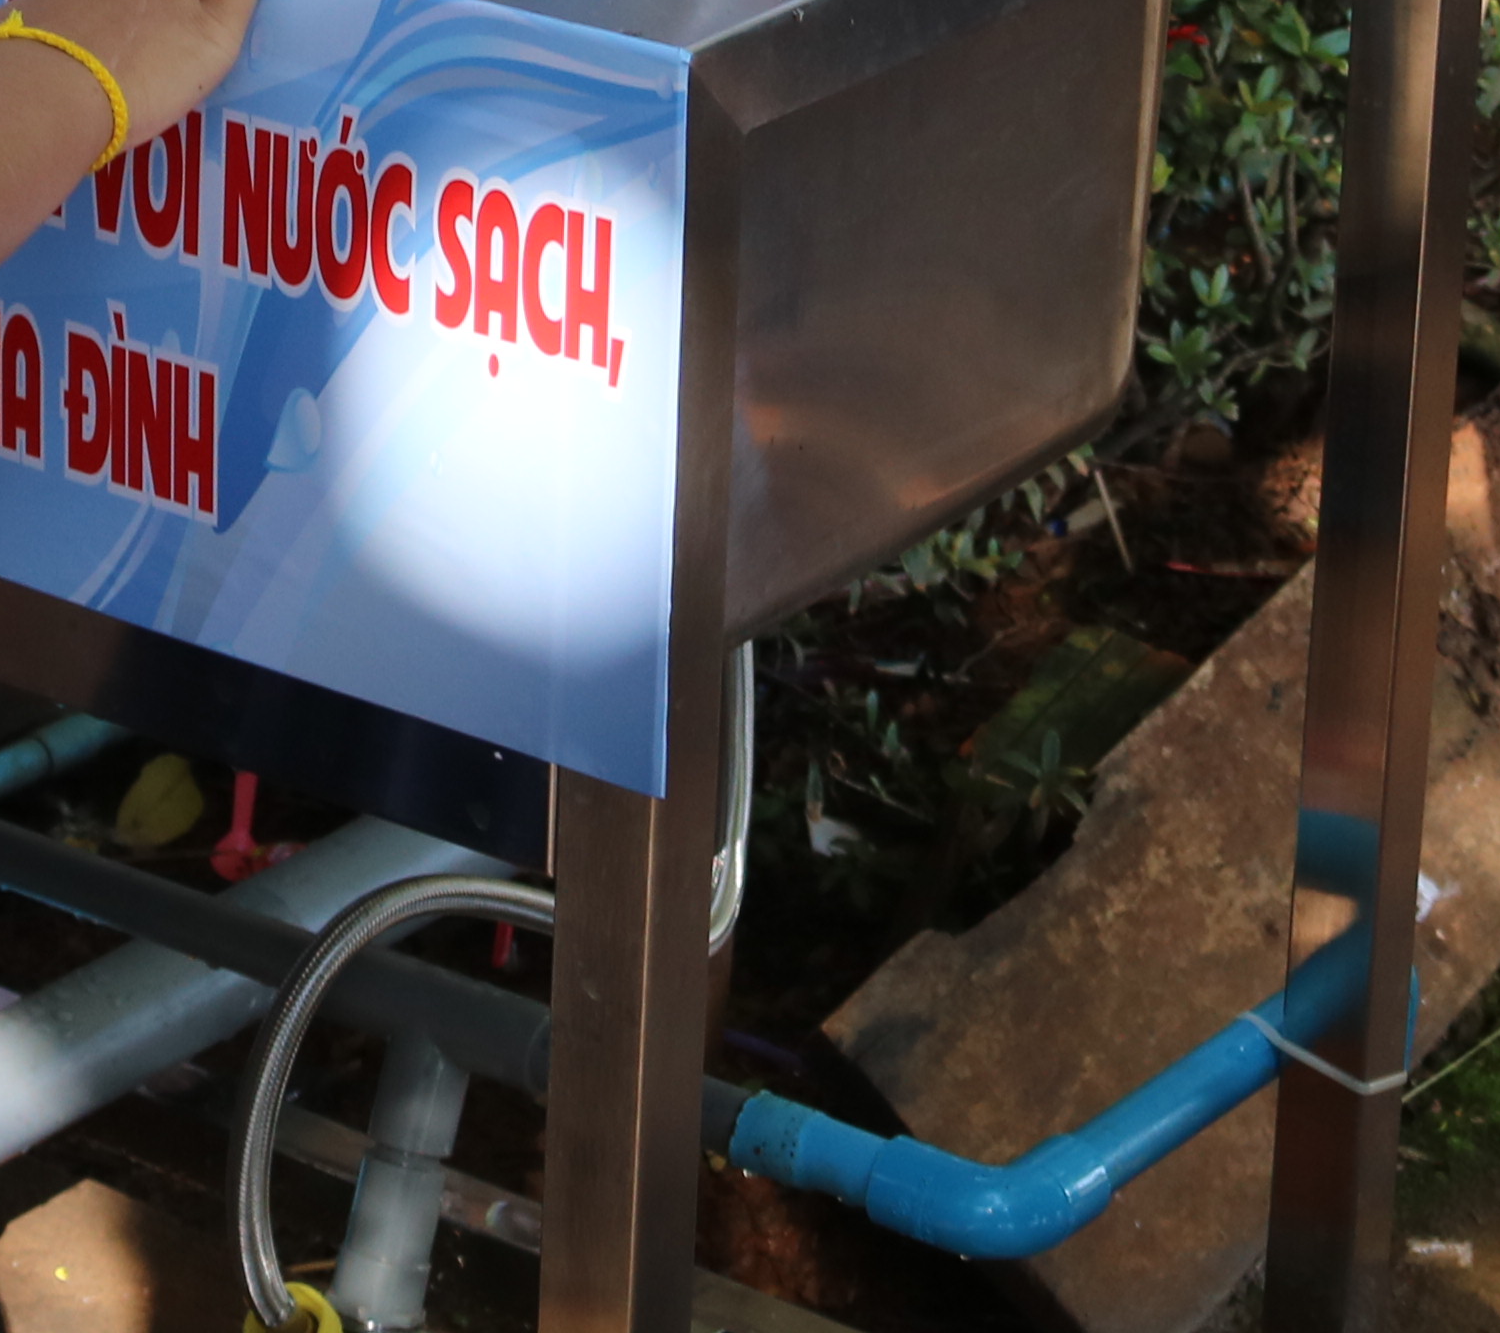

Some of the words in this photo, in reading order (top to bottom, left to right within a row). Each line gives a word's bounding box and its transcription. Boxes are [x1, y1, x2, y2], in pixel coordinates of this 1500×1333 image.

[224, 114, 413, 316] NƯỚC
[435, 178, 626, 388] SẠCH,
[65, 312, 216, 513] ĐÌNH
